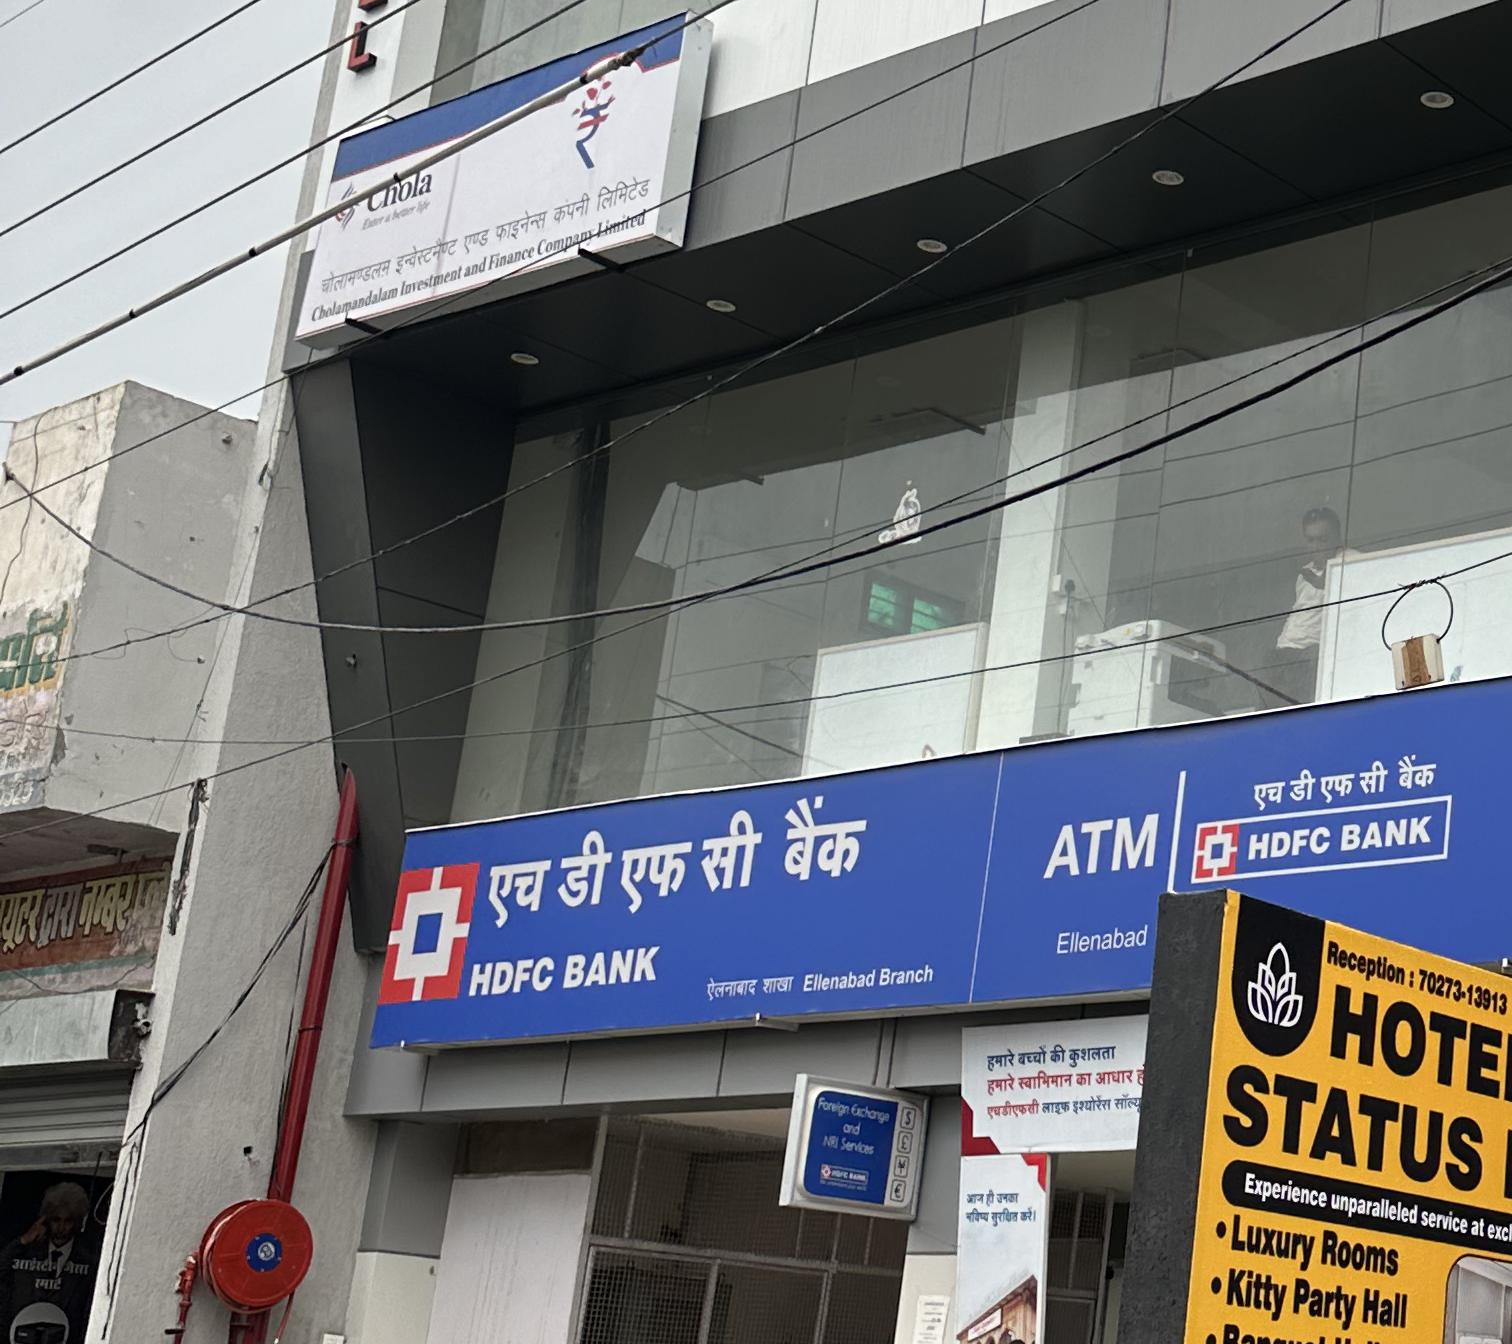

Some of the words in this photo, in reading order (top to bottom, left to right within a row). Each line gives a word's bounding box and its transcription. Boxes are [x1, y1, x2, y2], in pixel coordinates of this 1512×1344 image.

[366, 169, 433, 213] Chola
[311, 288, 398, 322] Cholamandalam
[400, 270, 462, 298] Investment
[464, 259, 487, 278] and
[487, 247, 535, 273] Finance
[537, 229, 596, 257] Company
[597, 208, 647, 239] Limited
[1253, 780, 1283, 811] एच
[1288, 768, 1316, 803] डी
[1321, 772, 1355, 804] एफ
[1358, 760, 1388, 794] सी
[1397, 754, 1438, 791] बैंक
[487, 859, 551, 929] एच
[556, 830, 613, 908] डी
[620, 841, 694, 915] एफ
[700, 809, 762, 892] सी
[782, 795, 868, 882] बैंक
[1042, 813, 1160, 880] ATM
[1248, 826, 1332, 861] HDFC
[1340, 814, 1434, 852] BANK
[1055, 924, 1149, 954] Ellenabad
[467, 956, 556, 998] HDFC
[562, 946, 661, 990] BANK
[761, 975, 794, 996] शाखा
[802, 967, 876, 992] Ellenabad
[878, 964, 934, 987] Branch
[1326, 940, 1406, 986] Reception
[1418, 968, 1508, 1016] 70273-13913
[987, 1049, 1015, 1071] हमारे
[1050, 1044, 1065, 1064] की
[1068, 1045, 1117, 1068] कुशलता
[987, 1073, 1015, 1095] हमारे
[1018, 1070, 1073, 1091] स्वाभिमान
[1076, 1072, 1092, 1087] का
[1095, 1069, 1133, 1085] आधार
[817, 1097, 849, 1116] Foreign
[850, 1104, 890, 1124] Exchange
[842, 1122, 861, 1135] and
[1222, 1063, 1484, 1193] STATUS
[823, 1136, 839, 1149] NRI
[841, 1137, 875, 1155] Services
[1243, 1172, 1328, 1208] Experience
[1330, 1191, 1418, 1226] unparalleled
[1420, 1209, 1468, 1236] service
[1470, 1218, 1485, 1237] at
[1230, 1214, 1316, 1272] Luxury
[1321, 1229, 1400, 1277] Rooms
[1226, 1268, 1288, 1320] Kitty
[1292, 1279, 1357, 1331] Party
[1362, 1287, 1408, 1330] Hall
